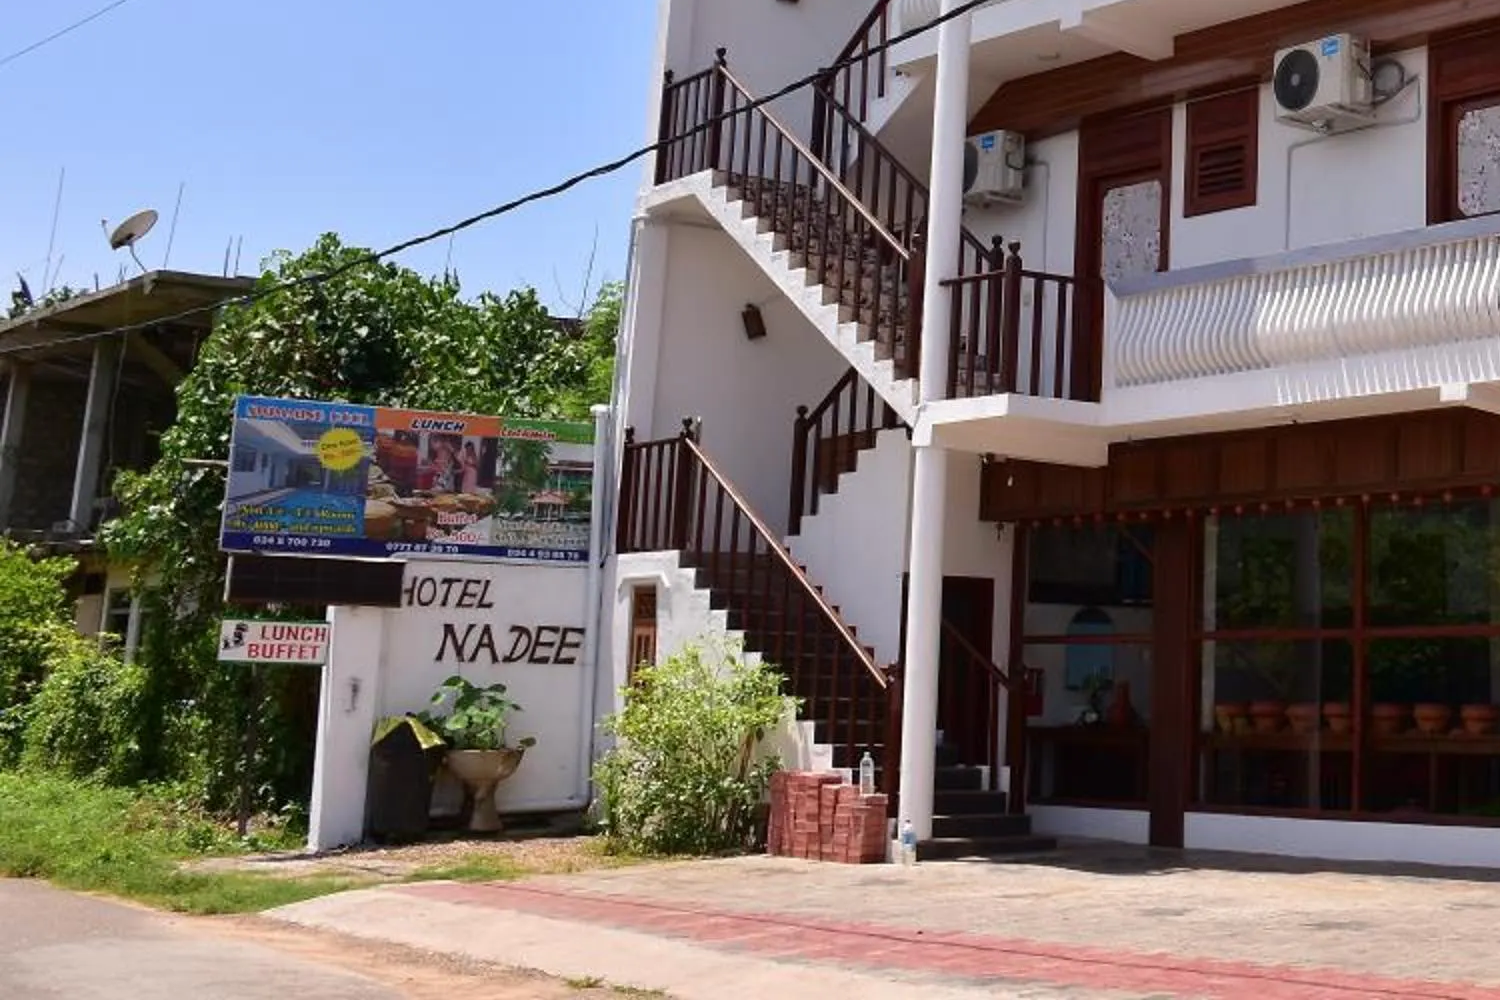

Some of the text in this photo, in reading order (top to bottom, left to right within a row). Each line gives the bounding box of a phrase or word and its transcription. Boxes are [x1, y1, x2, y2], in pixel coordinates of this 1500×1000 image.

[411, 417, 467, 433] LUNCH
[402, 576, 494, 609] HOTEL
[260, 625, 327, 642] LUNCH
[247, 643, 321, 659] BUFFET
[435, 623, 586, 665] NADEE
